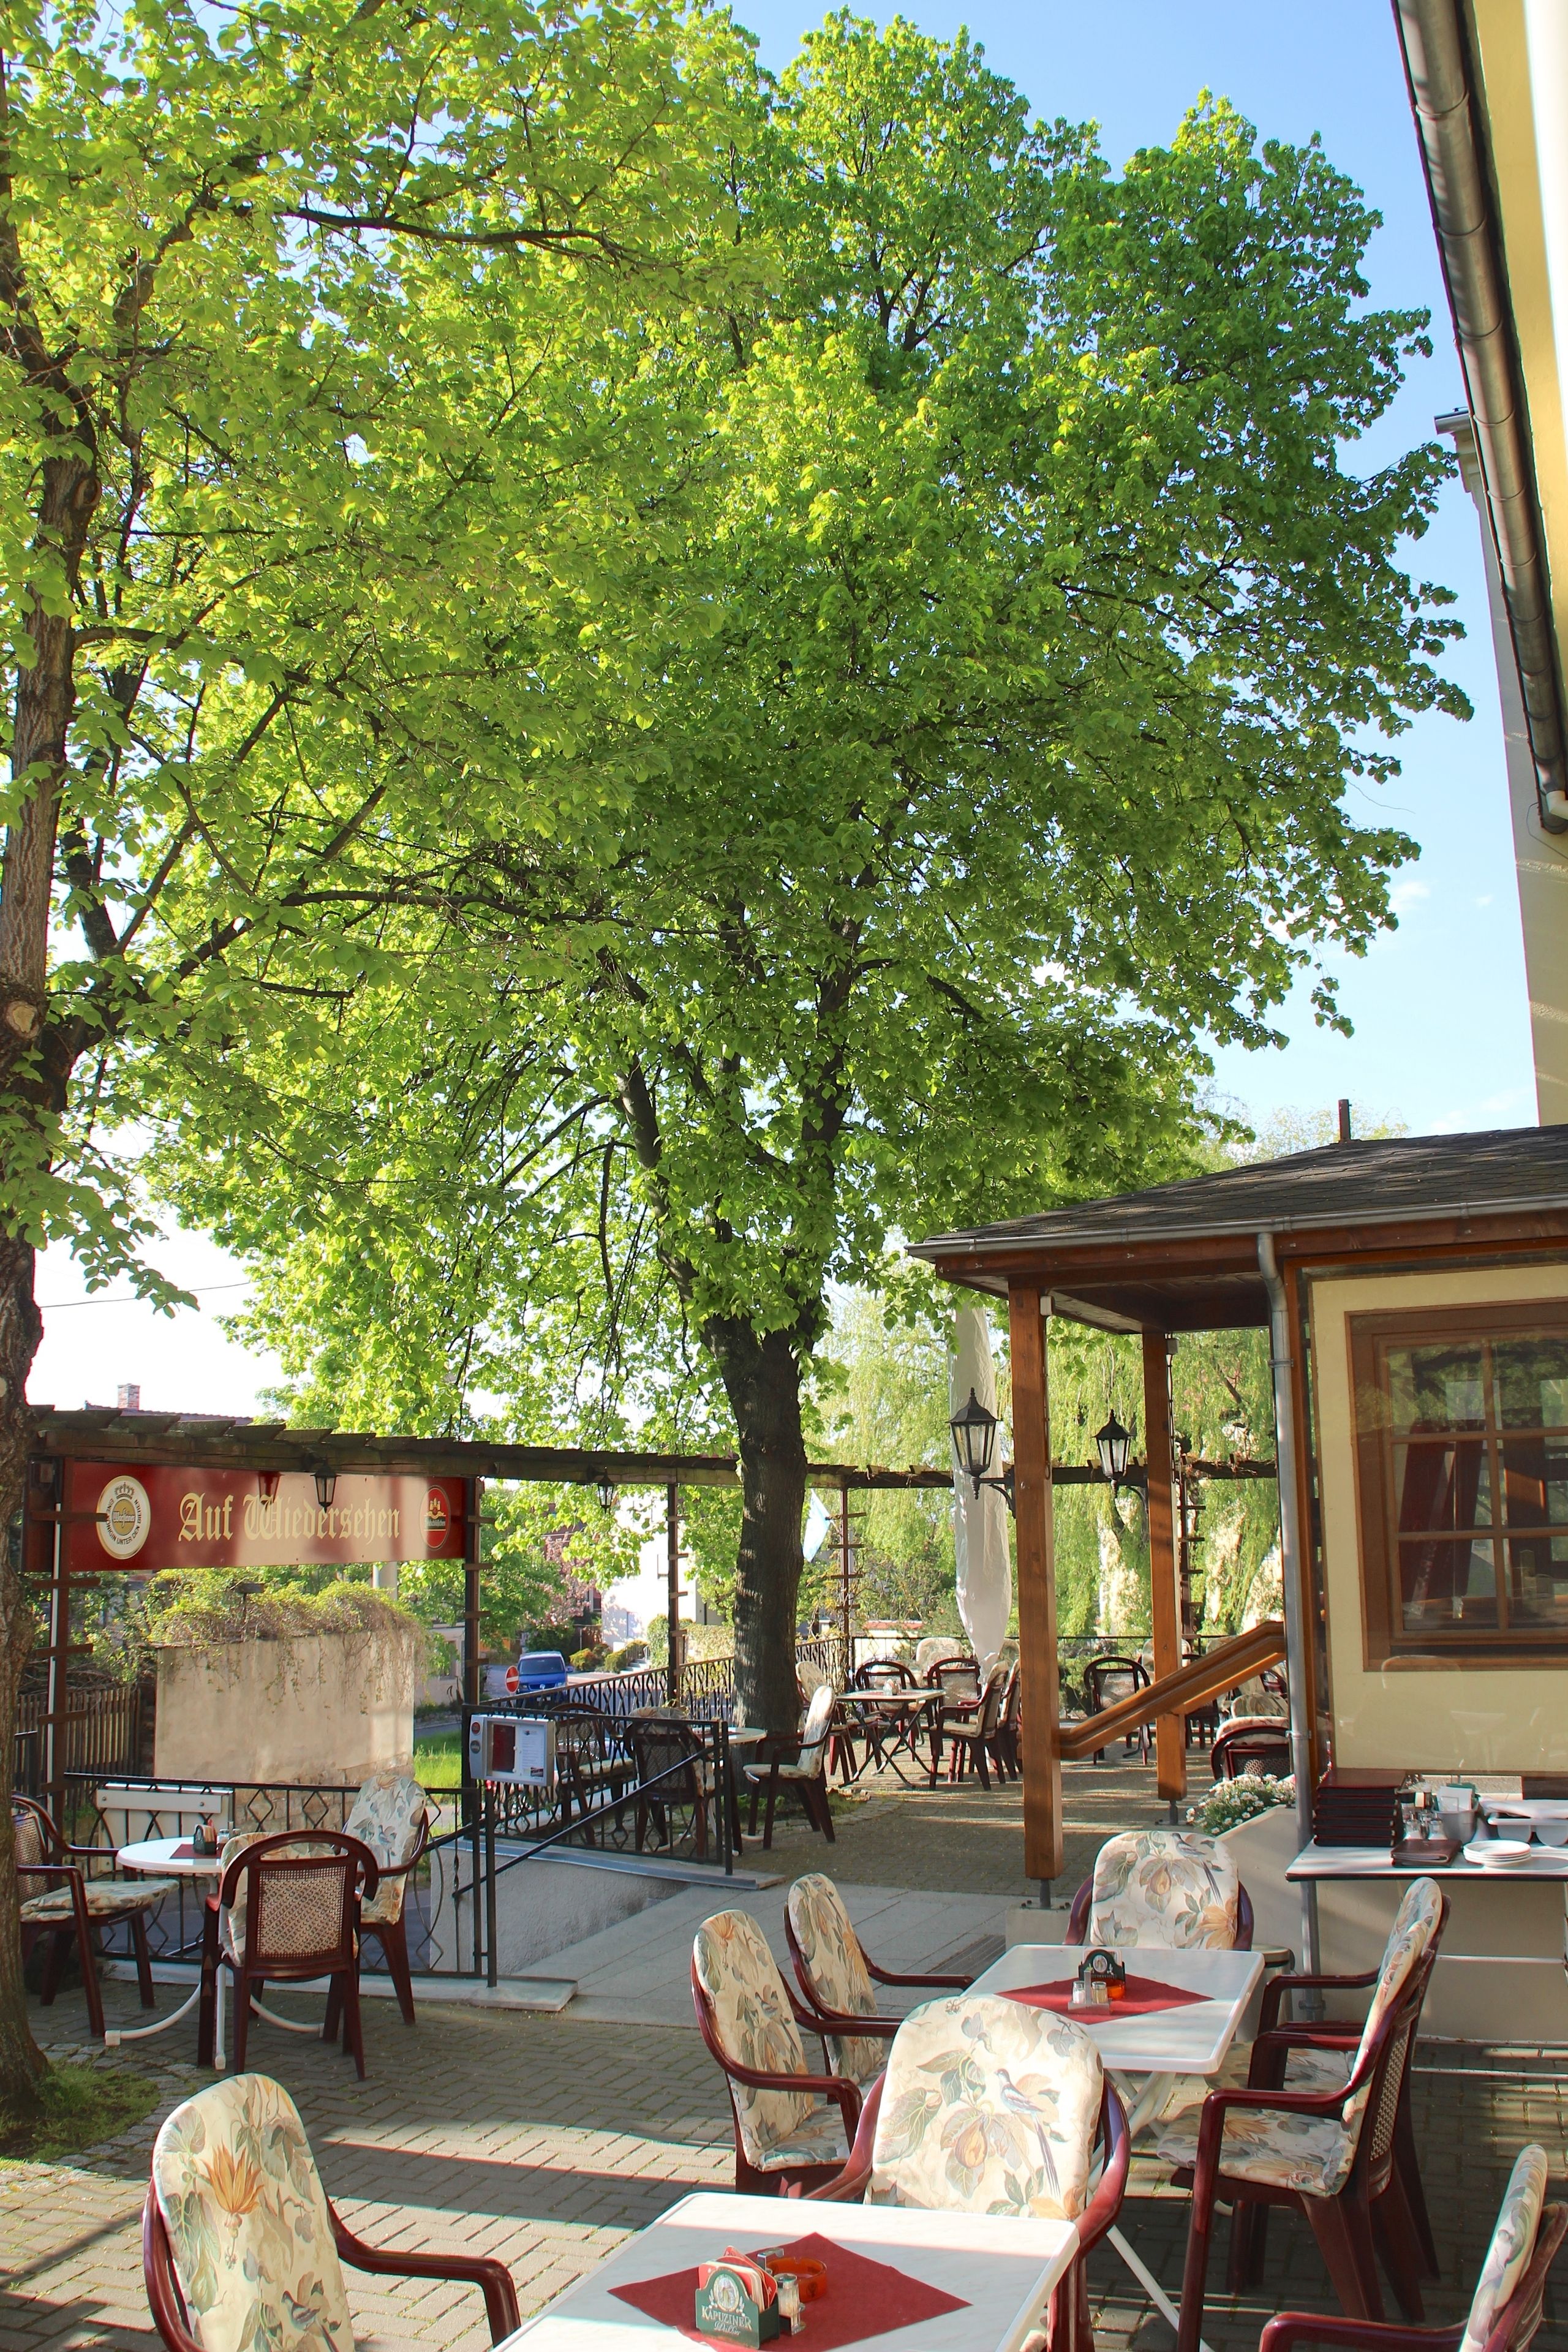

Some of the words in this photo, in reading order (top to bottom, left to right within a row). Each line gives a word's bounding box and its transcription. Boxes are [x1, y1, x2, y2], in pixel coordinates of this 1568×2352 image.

[178, 1492, 234, 1542] Auf
[243, 1494, 400, 1545] Wiedersehen
[116, 1536, 133, 1545] UNTER
[132, 1525, 140, 1539] DEN
[701, 2305, 752, 2331] KAPUZINER
